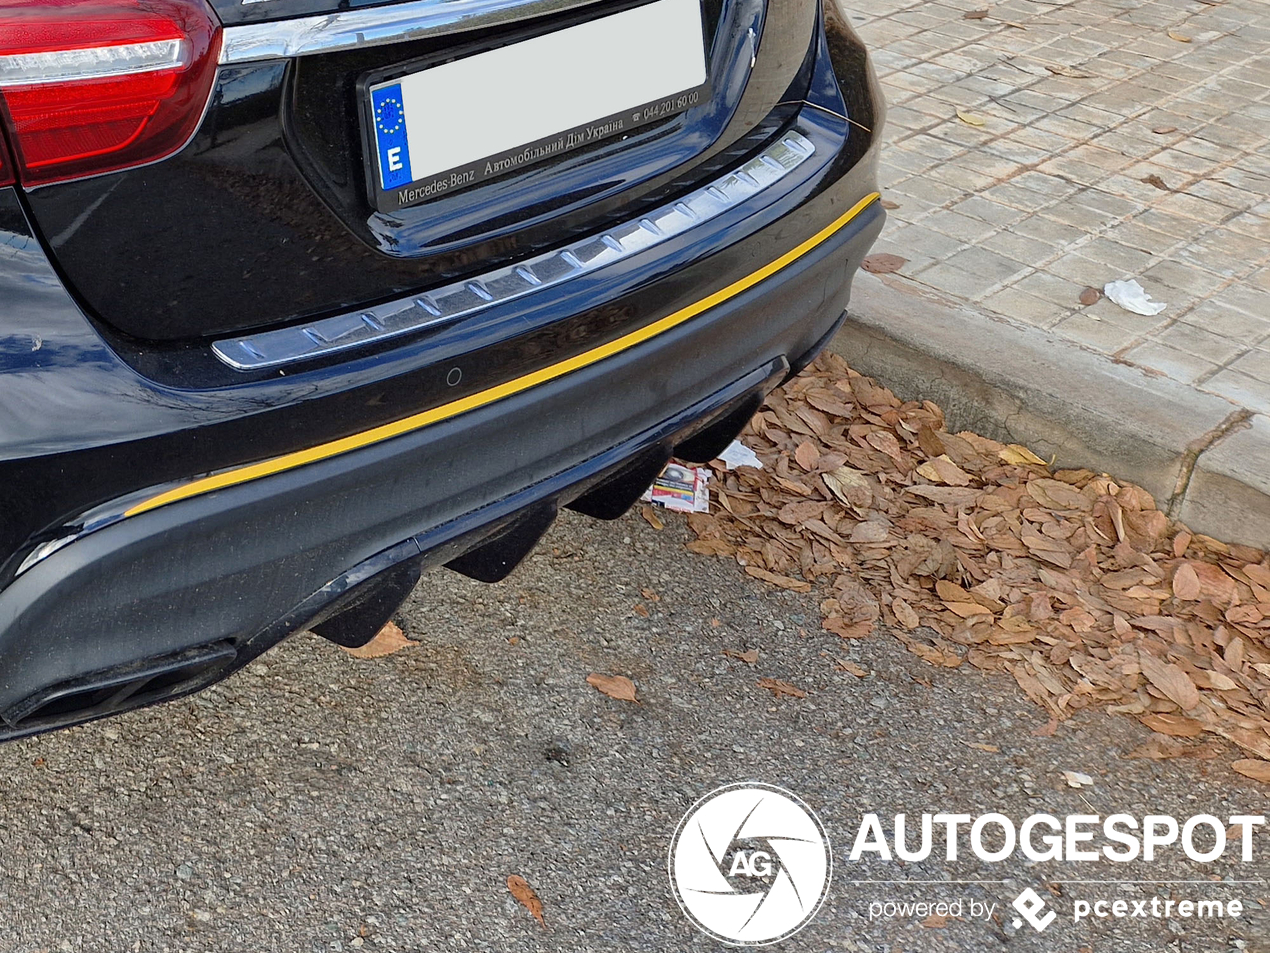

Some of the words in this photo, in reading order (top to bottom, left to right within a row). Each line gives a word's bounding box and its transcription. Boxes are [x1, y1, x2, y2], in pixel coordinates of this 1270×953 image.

[387, 146, 403, 172] E
[398, 170, 475, 205] Mercedes-Benz
[483, 137, 564, 175] Автомобільний
[565, 131, 585, 150] Дім
[585, 119, 624, 140] Україна
[643, 105, 660, 121] 044
[659, 100, 675, 116] 201
[677, 95, 688, 108] 60
[688, 91, 699, 104] 00
